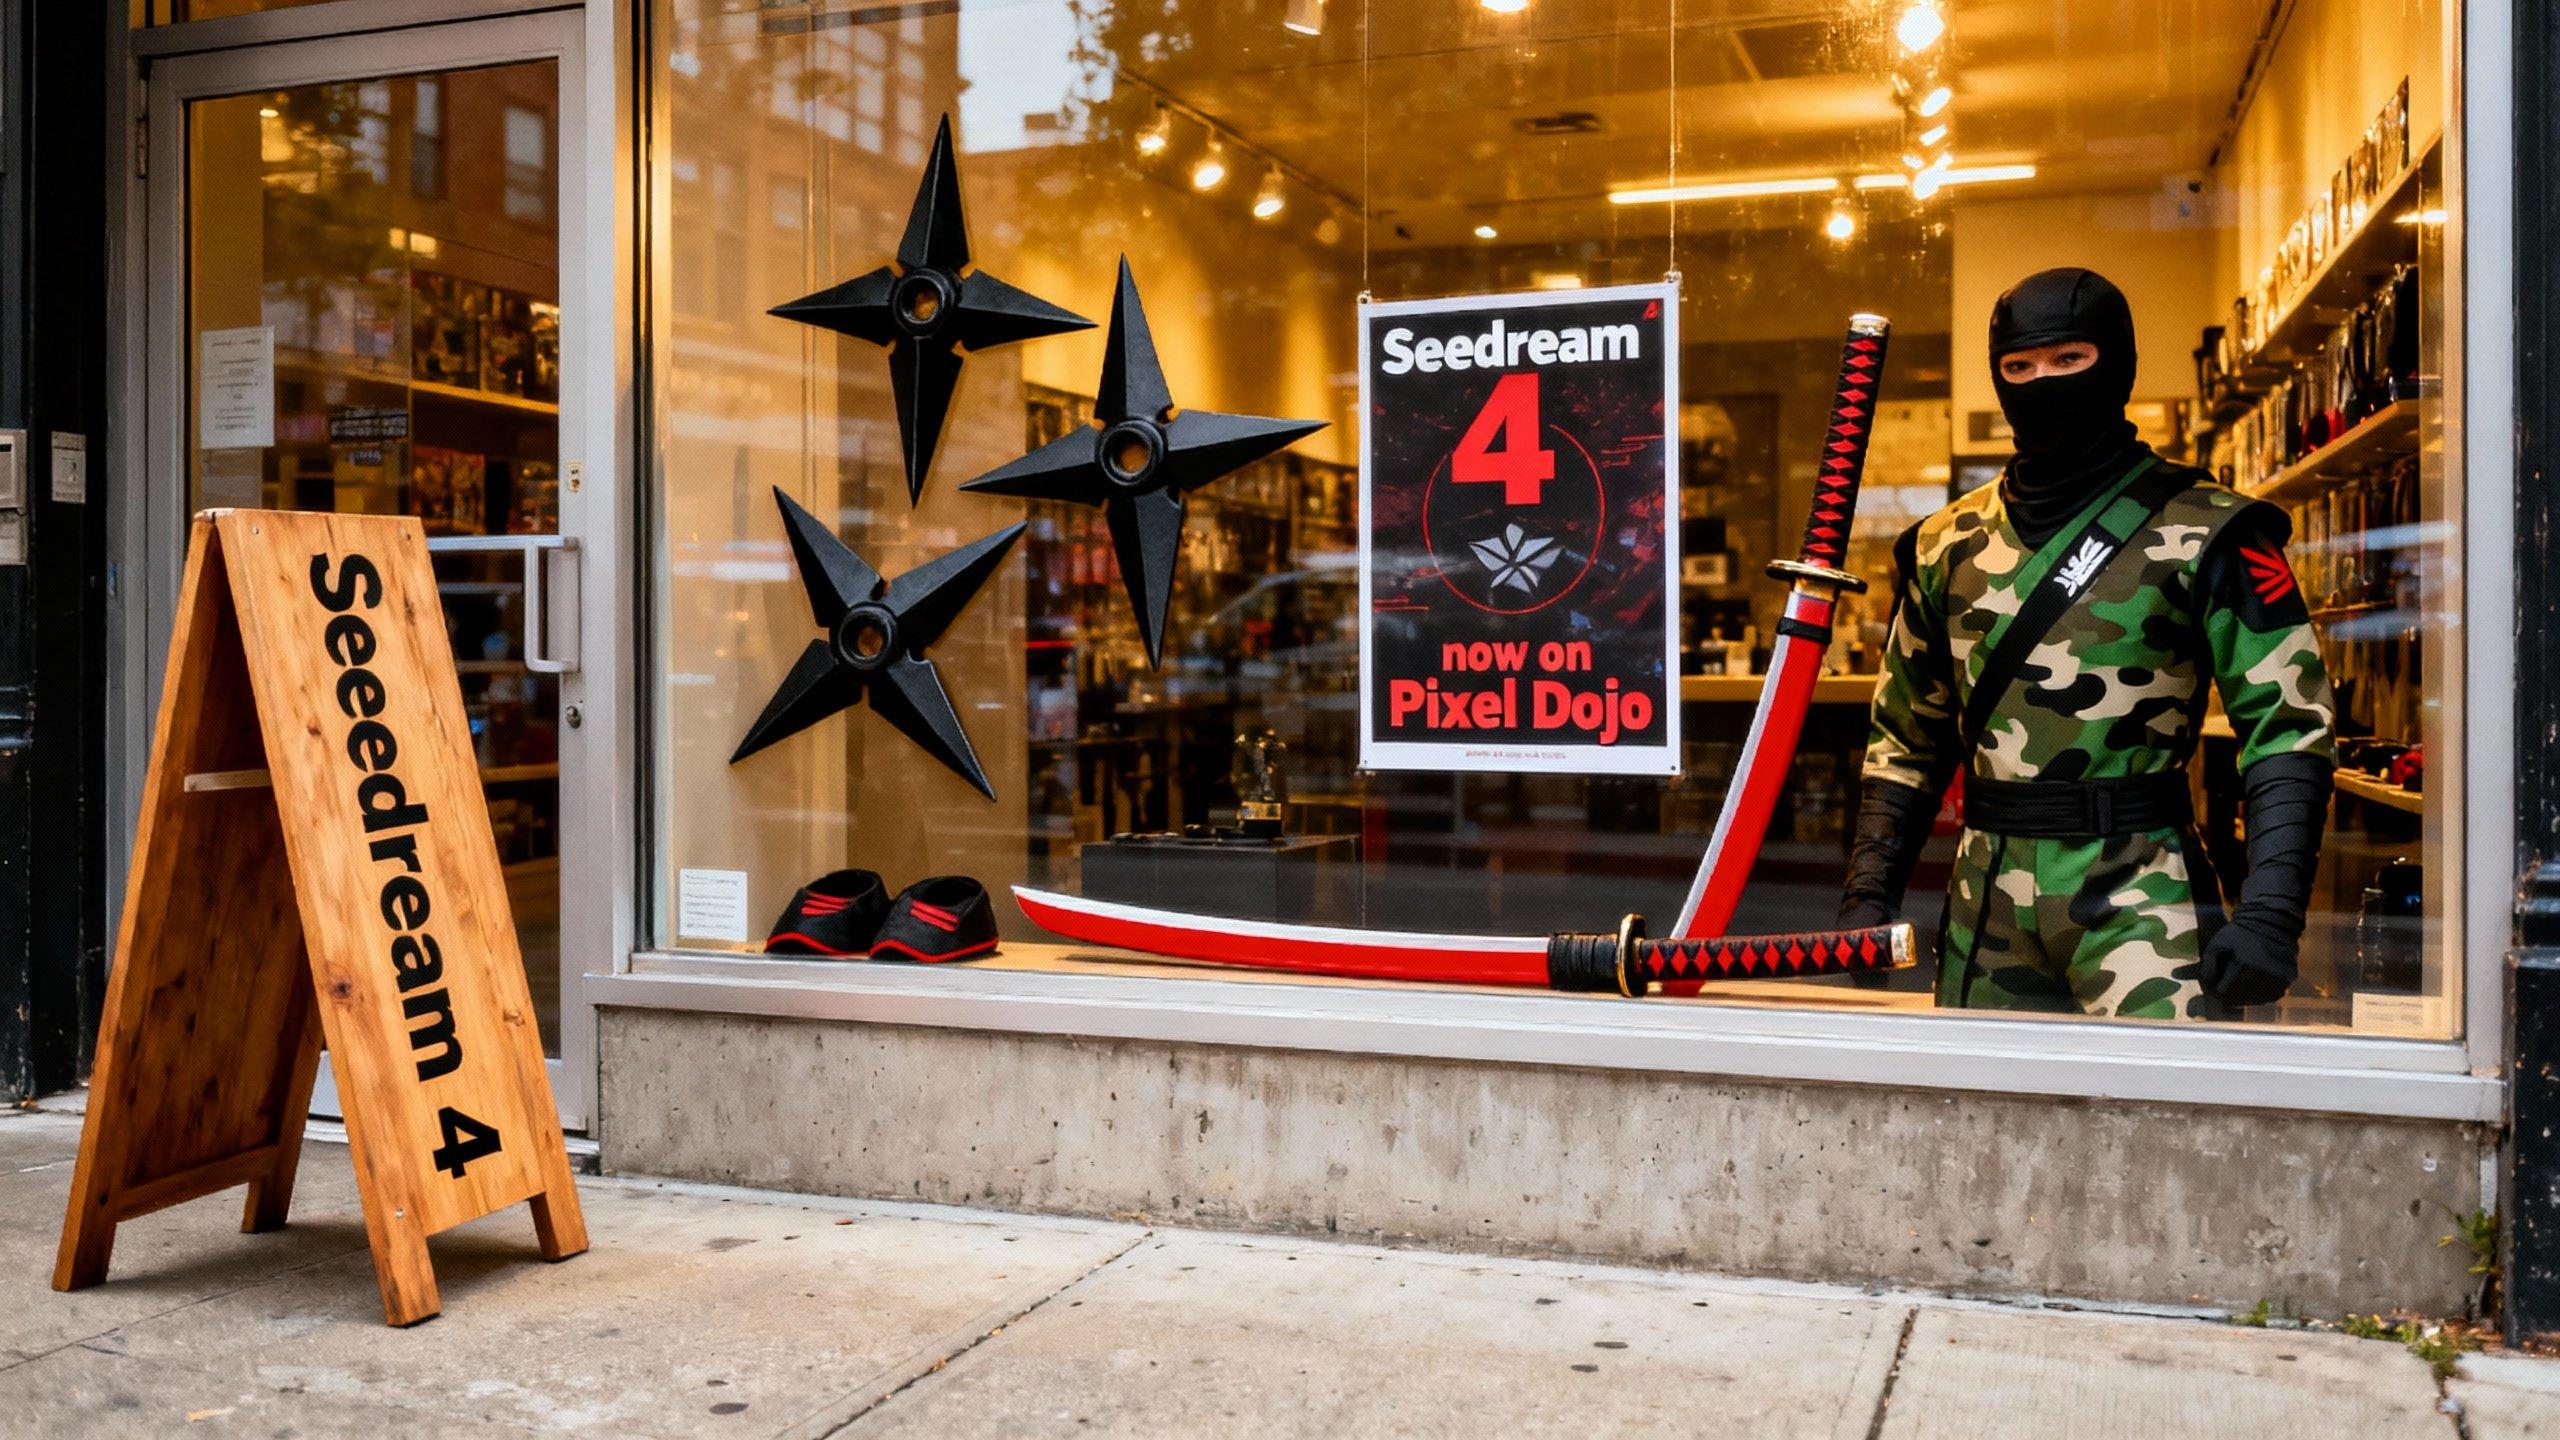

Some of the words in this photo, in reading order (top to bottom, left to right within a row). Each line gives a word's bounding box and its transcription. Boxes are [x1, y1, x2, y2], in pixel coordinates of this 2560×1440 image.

[1382, 319, 1640, 375] Seedream
[1451, 372, 1555, 506] 4
[1442, 641, 1529, 672] now
[1538, 641, 1592, 672] on
[1389, 677, 1518, 729] Pixel
[1532, 677, 1653, 746] Dojo
[310, 552, 464, 1082] Seeedream
[432, 1106, 503, 1180] 4
